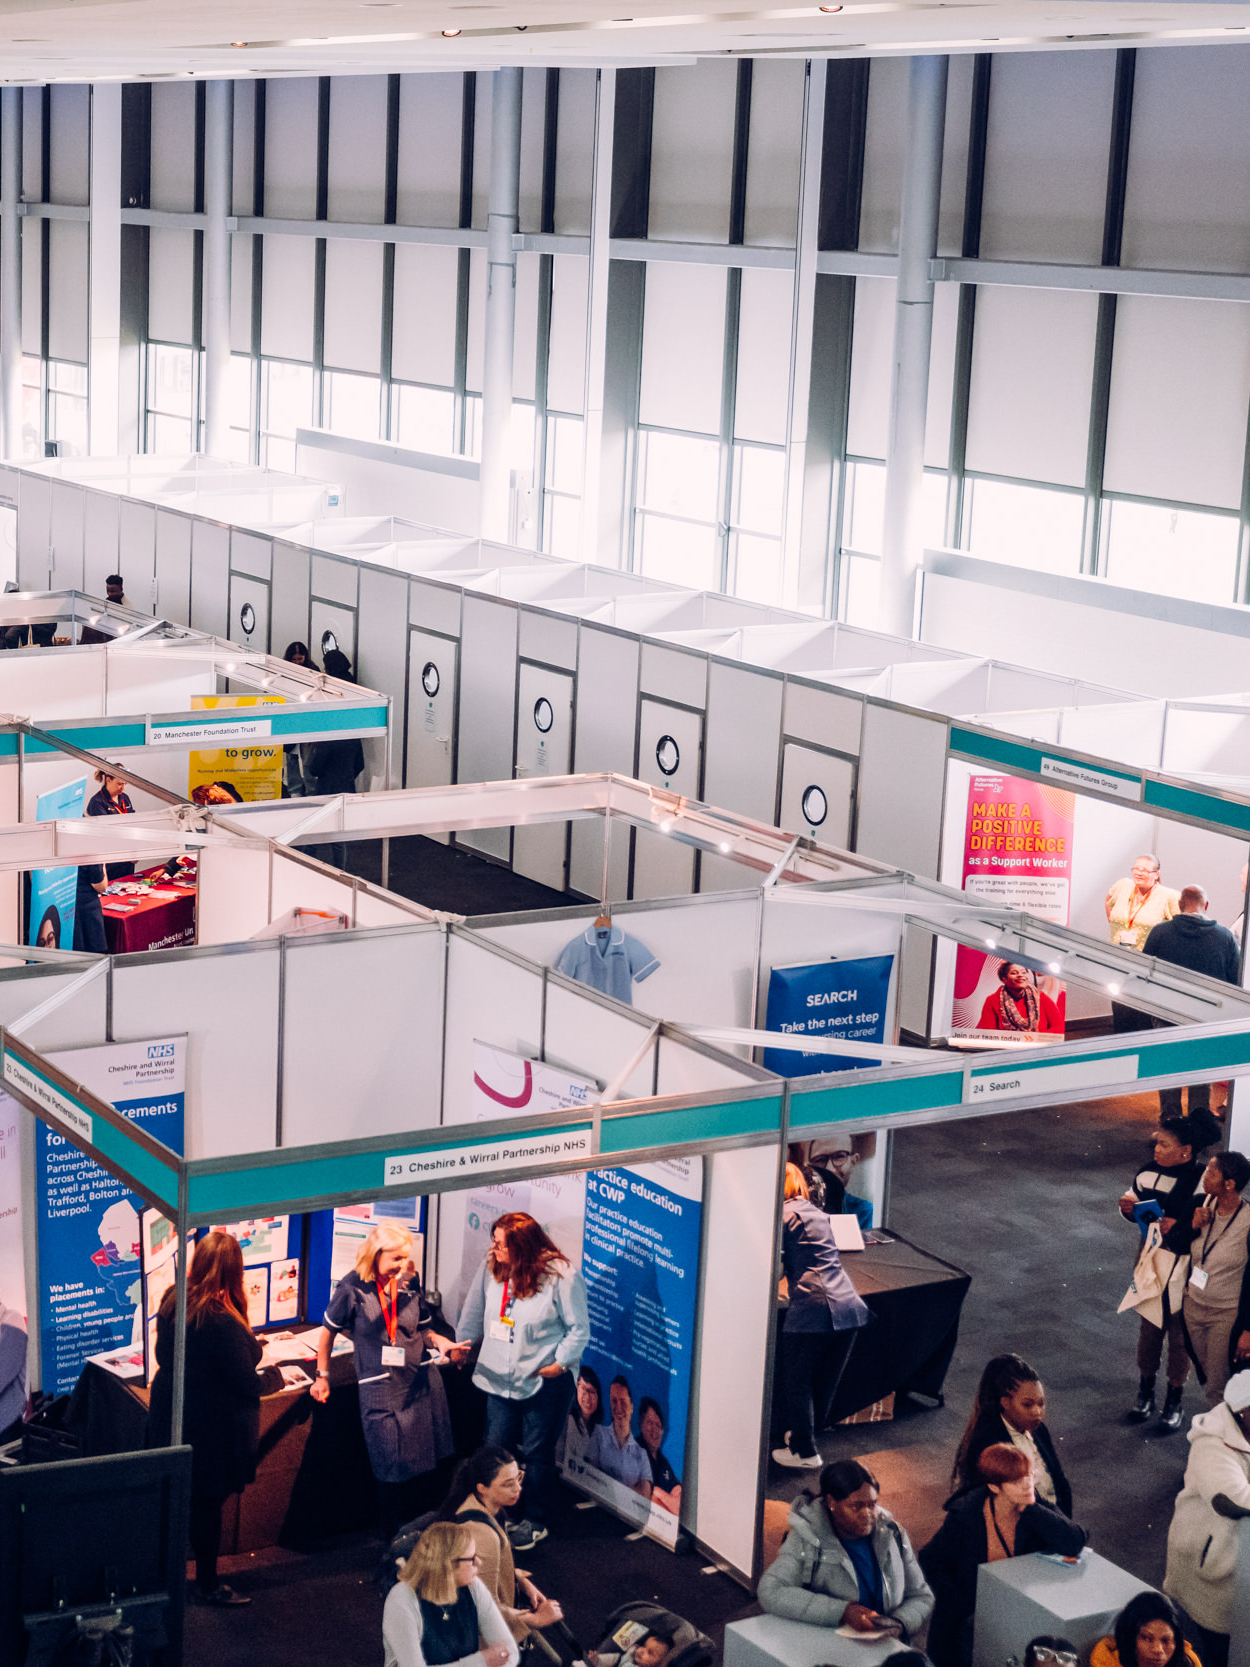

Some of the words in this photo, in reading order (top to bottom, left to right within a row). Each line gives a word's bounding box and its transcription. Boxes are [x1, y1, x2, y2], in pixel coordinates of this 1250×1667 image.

[164, 729, 202, 739] Manchester
[203, 727, 239, 737] Foundation
[241, 725, 257, 734] Trust
[225, 747, 238, 757] to
[241, 748, 277, 760] grow.
[1052, 765, 1080, 779] Alternative
[1080, 773, 1100, 785] Futures
[1101, 779, 1119, 790] Group
[973, 802, 1017, 818] MAKE
[1020, 802, 1031, 818] A
[971, 818, 1043, 835] POSITIVE
[970, 835, 1066, 853] DIFFERENCE
[968, 857, 981, 865] as
[982, 857, 989, 866] a
[991, 856, 1030, 868] Support
[1032, 857, 1068, 868] Worker
[148, 930, 184, 951] Manchester
[806, 989, 858, 1007] SEARCH
[779, 1021, 805, 1034] Take
[807, 1018, 826, 1030] the
[827, 1013, 853, 1027] next
[855, 1012, 880, 1027] step
[847, 1027, 877, 1039] career
[147, 1043, 174, 1059] NHS
[108, 1064, 138, 1074] Cheshire
[139, 1061, 153, 1070] and
[154, 1058, 175, 1068] Wirral
[135, 1066, 175, 1079] Partnership
[973, 1084, 984, 1094] 24
[989, 1080, 1021, 1093] Search
[13, 1068, 33, 1090] Cheshire
[38, 1086, 51, 1104] Wirral
[51, 1096, 78, 1125] Partnership
[78, 1118, 90, 1133] NHS
[7, 1124, 17, 1138] in
[46, 1149, 86, 1164] Cheshire
[389, 1164, 403, 1176] 23
[408, 1157, 456, 1174] Cheshire
[459, 1156, 466, 1167] &
[469, 1151, 500, 1165] Wirral
[502, 1142, 561, 1161] Partnership
[563, 1138, 586, 1151] NHS
[587, 1178, 598, 1193] at
[598, 1183, 626, 1204] CWP
[630, 1181, 683, 1217] education
[47, 1205, 92, 1219] Liverpool.
[586, 1196, 599, 1210] Our
[598, 1204, 628, 1225] practice
[628, 1217, 663, 1242] education
[585, 1207, 622, 1233] facilitators
[621, 1226, 653, 1249] promote
[653, 1241, 674, 1259] multi-
[584, 1219, 626, 1247] professional
[625, 1239, 654, 1263] lifelong
[654, 1252, 685, 1279] learning
